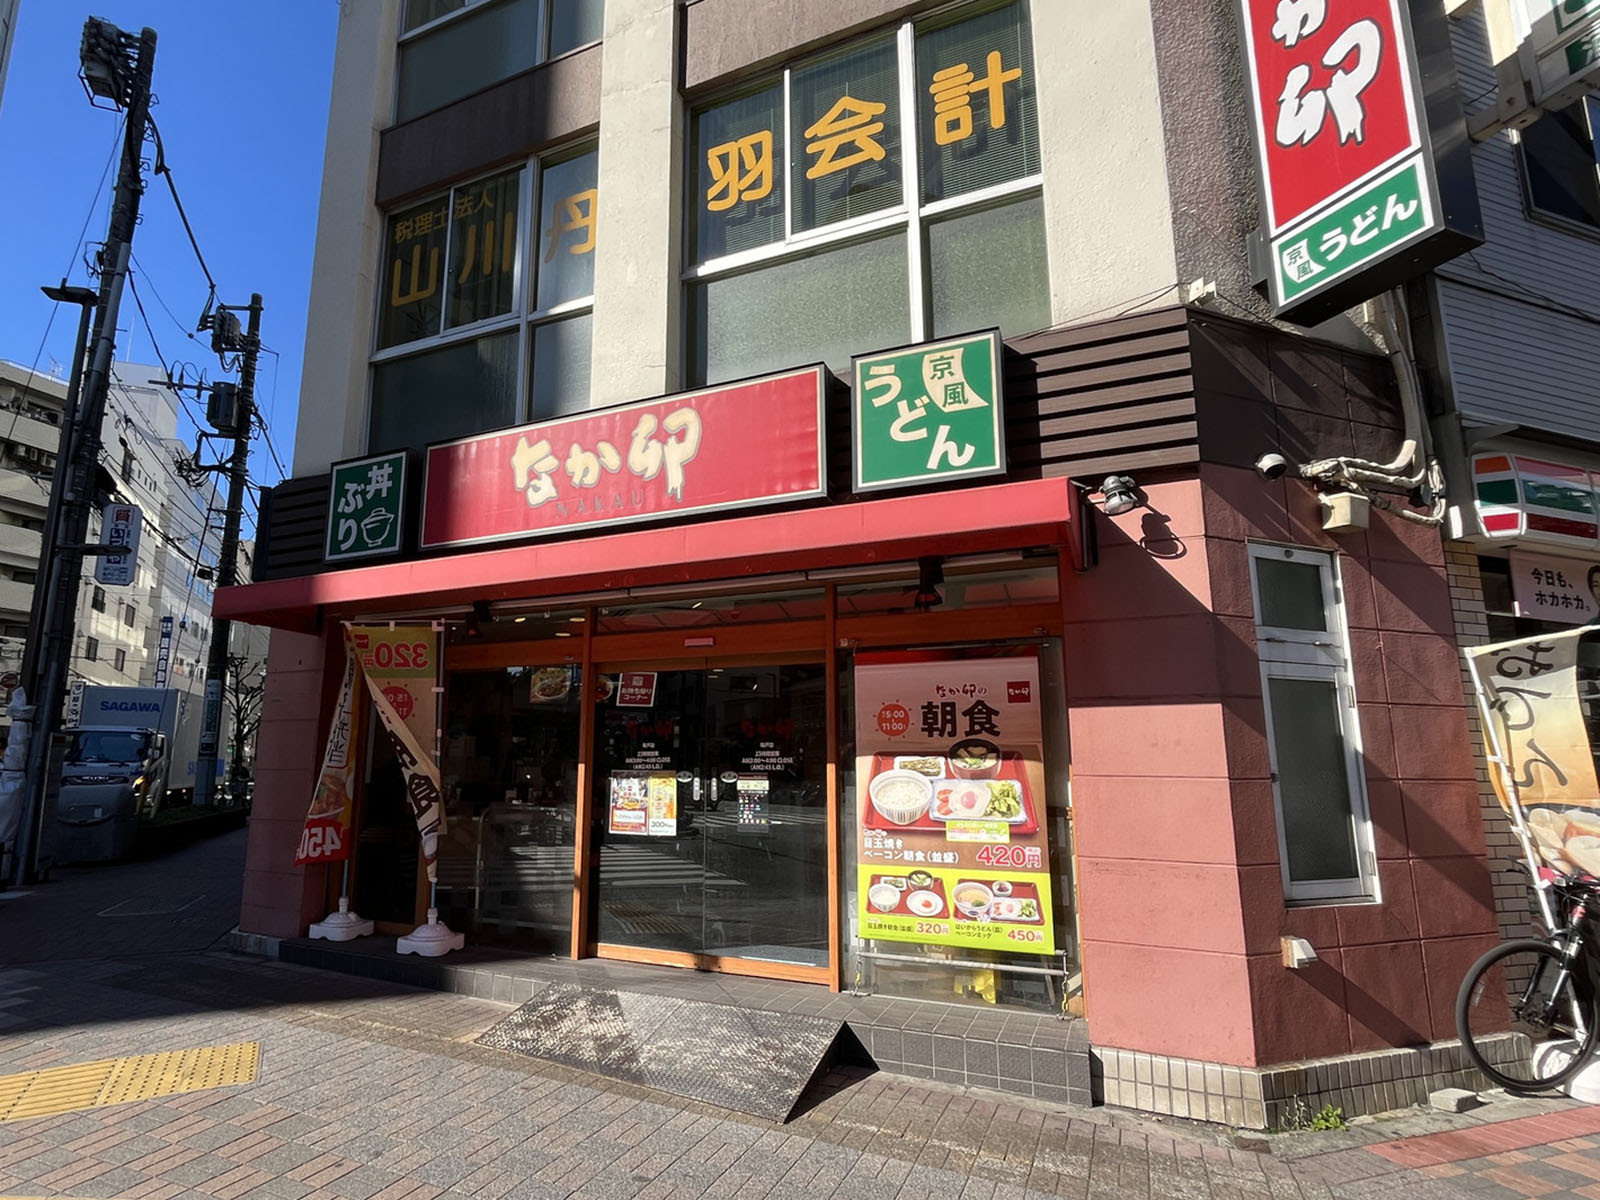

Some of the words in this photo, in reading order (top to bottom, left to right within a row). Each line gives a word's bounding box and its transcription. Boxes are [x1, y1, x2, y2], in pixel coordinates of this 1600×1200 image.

[707, 50, 1022, 211] 羽会計
[393, 190, 493, 244] 税理士法人
[1319, 193, 1418, 263] うどん
[1286, 247, 1313, 282] 京風
[928, 354, 968, 408] 京風
[864, 364, 975, 469] うどん
[510, 407, 700, 508] なか卯
[1530, 566, 1574, 590] 今日も、
[99, 700, 161, 713] SAGAWA
[623, 694, 648, 702] コーナー
[935, 683, 988, 699] なか卯の
[920, 700, 1000, 738] 朝食
